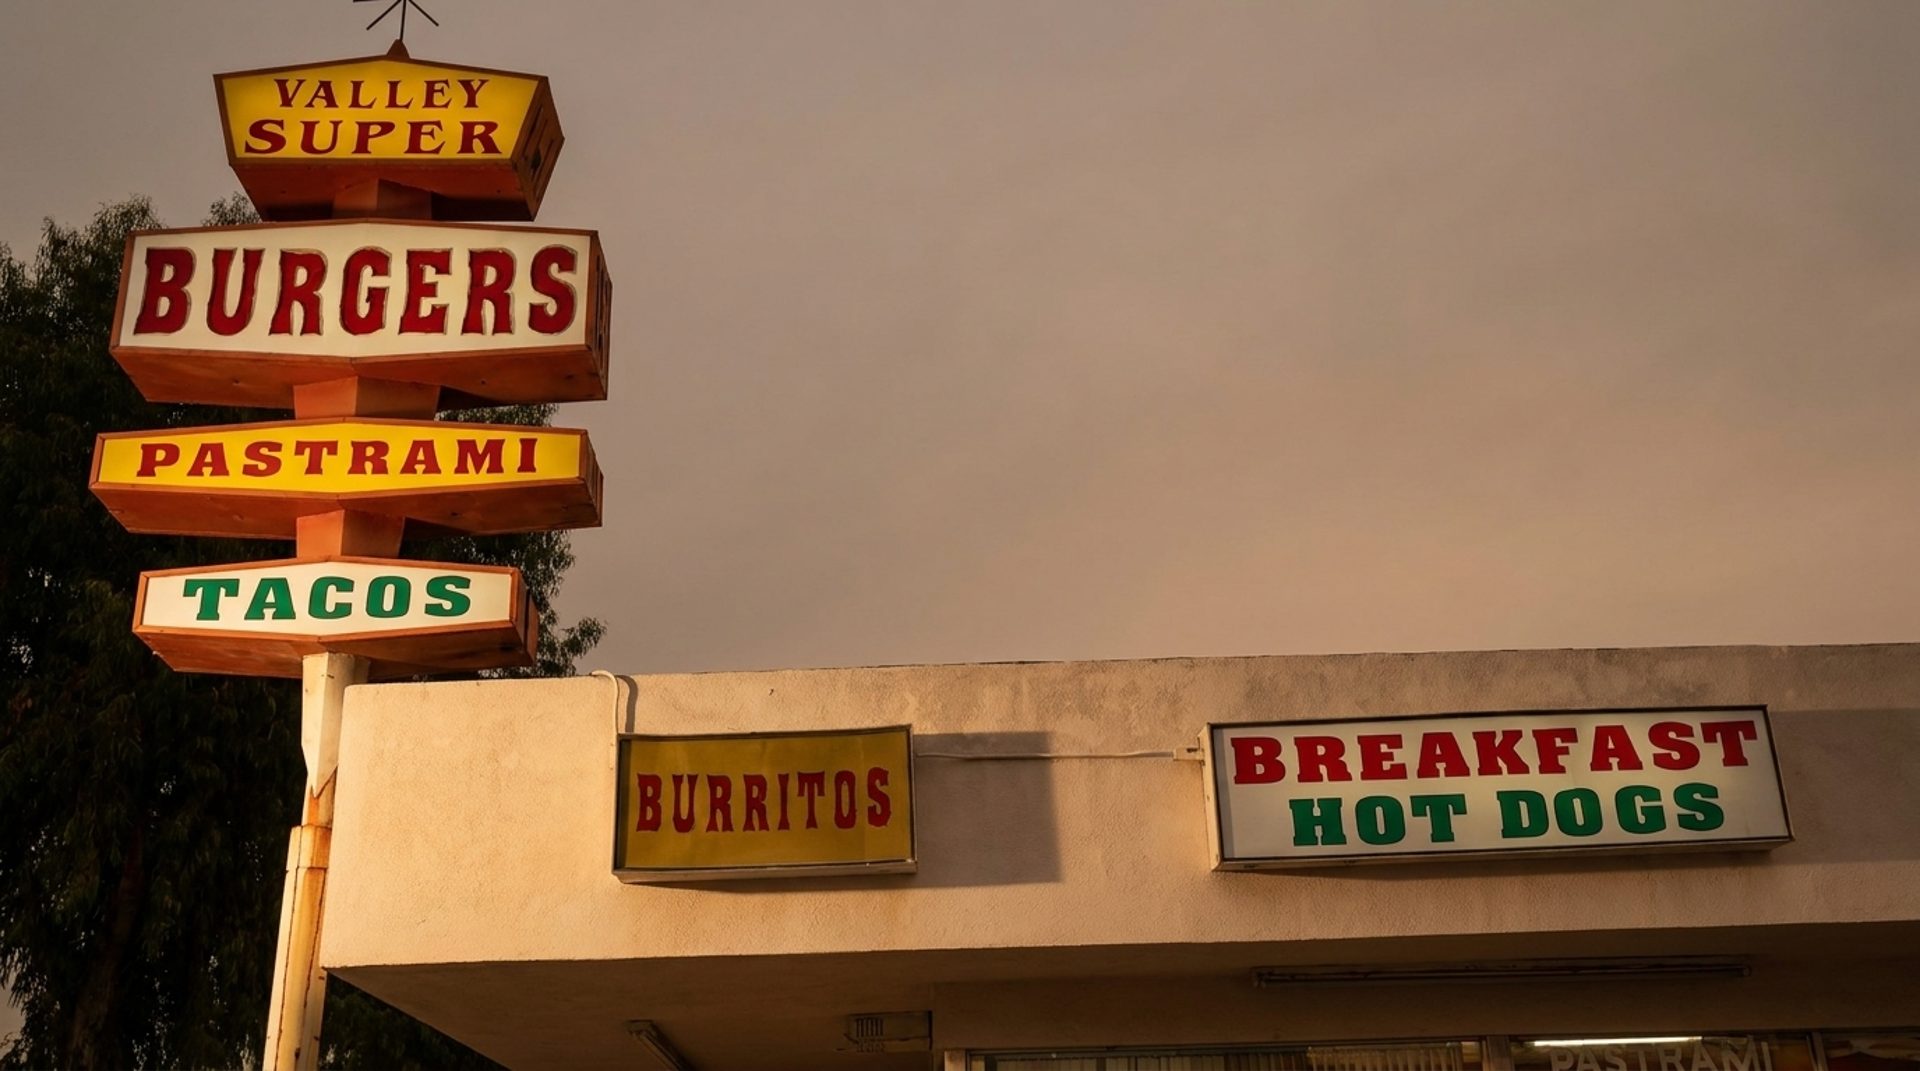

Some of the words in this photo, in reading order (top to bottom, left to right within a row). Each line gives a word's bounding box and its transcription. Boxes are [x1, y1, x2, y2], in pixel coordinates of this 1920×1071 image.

[274, 78, 489, 108] VALLEY
[244, 119, 502, 155] SUPER
[133, 244, 577, 336] BURGERS
[136, 437, 538, 477] PASTRAMI
[182, 575, 471, 620] TACOS
[1230, 720, 1758, 785] BREAKFAST
[636, 766, 892, 833] BURRITOS
[1289, 793, 1467, 846] HOT
[1496, 782, 1726, 838] DOGS
